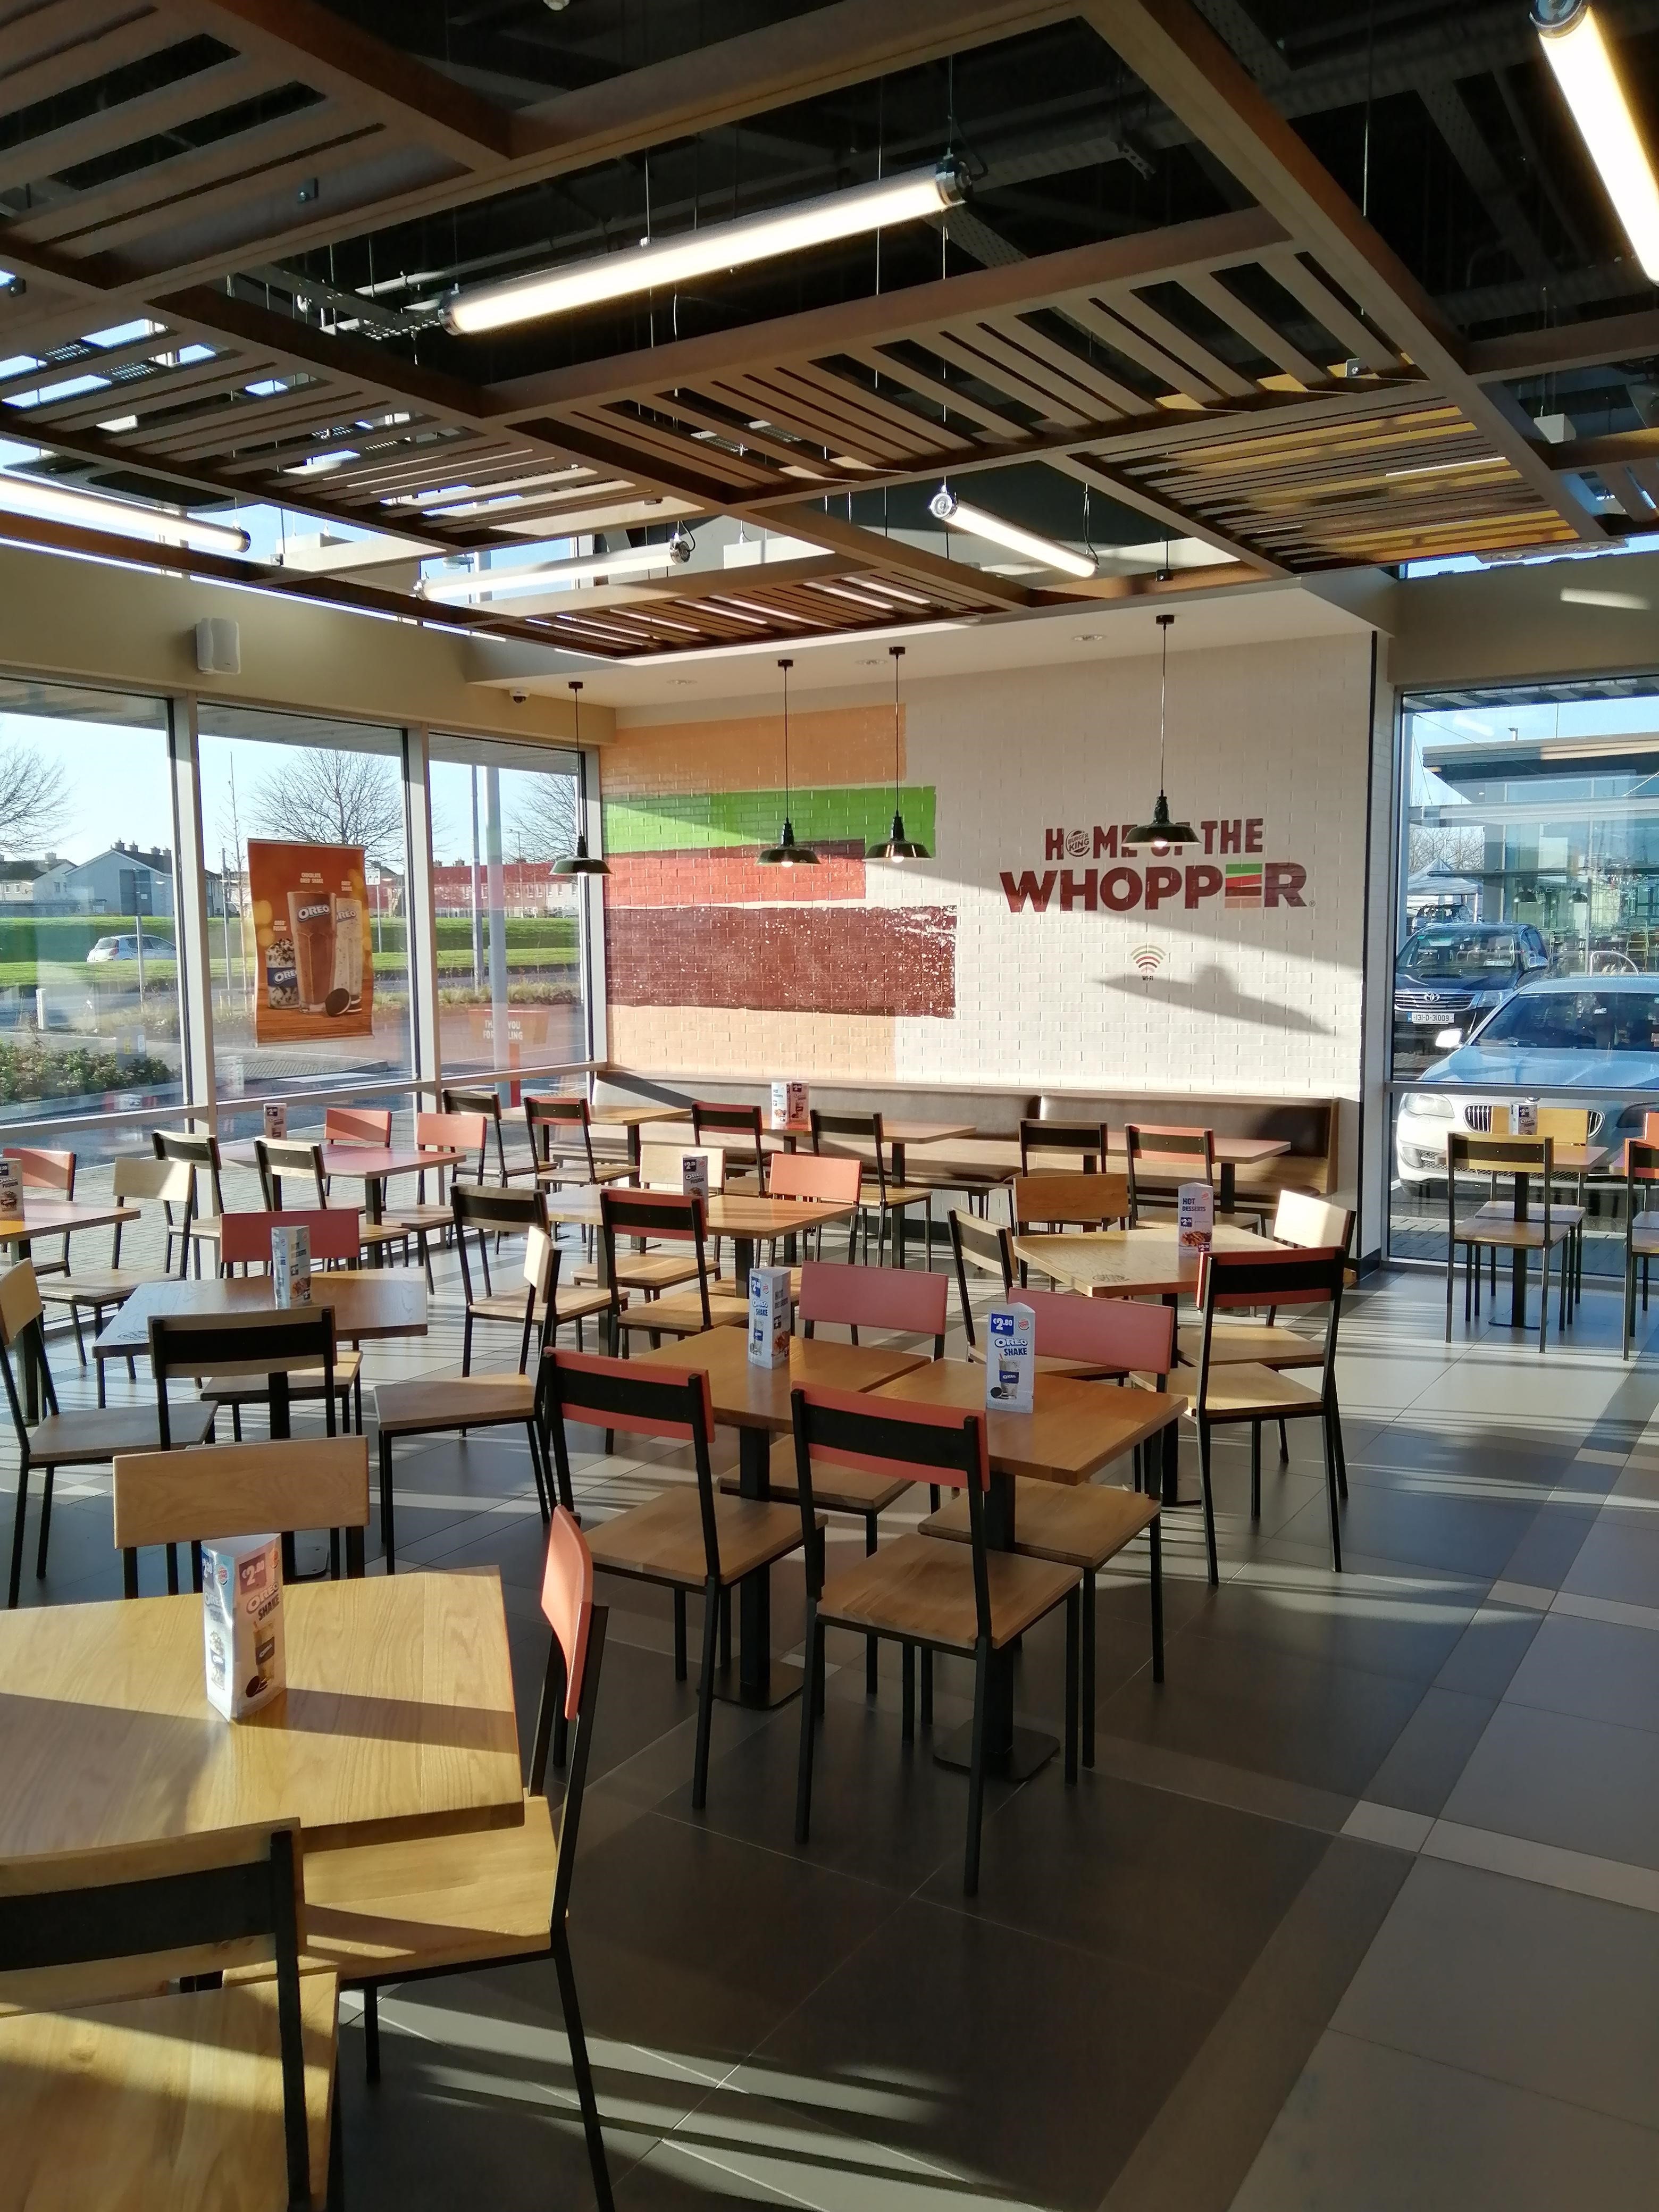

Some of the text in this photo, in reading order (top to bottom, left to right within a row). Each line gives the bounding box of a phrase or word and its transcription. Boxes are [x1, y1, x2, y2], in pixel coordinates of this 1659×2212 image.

[1068, 833, 1088, 845] BURGER
[1201, 818, 1263, 854] THE
[1069, 838, 1089, 851] KING
[298, 904, 330, 920] OREO
[274, 970, 297, 982] ORE
[507, 1020, 521, 1029] YOU
[508, 1031, 523, 1041] LING
[995, 1338, 1028, 1348] OREO
[1004, 1347, 1027, 1356] SHAKE
[247, 1581, 279, 1613] OREO
[258, 1594, 280, 1621] SHAKE
